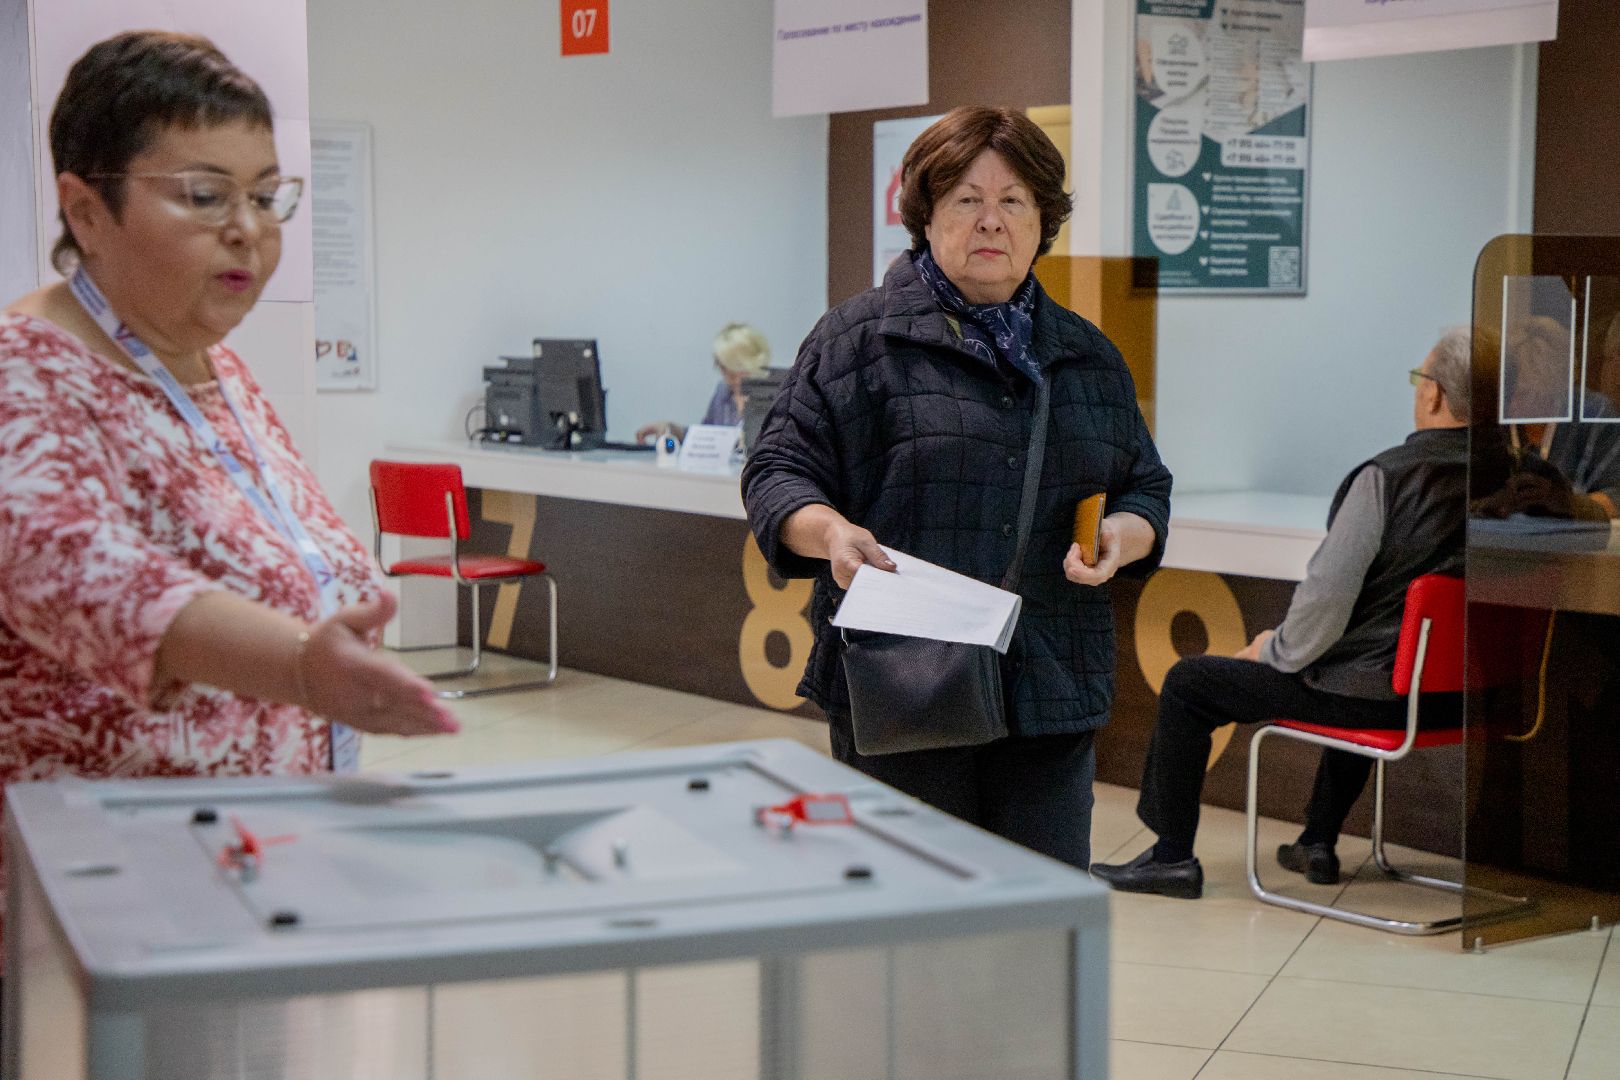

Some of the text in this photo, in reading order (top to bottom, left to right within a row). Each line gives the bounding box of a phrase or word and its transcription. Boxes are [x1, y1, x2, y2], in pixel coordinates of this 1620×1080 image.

[572, 9, 597, 38] 07
[482, 489, 536, 649] 7
[739, 528, 815, 710] 8
